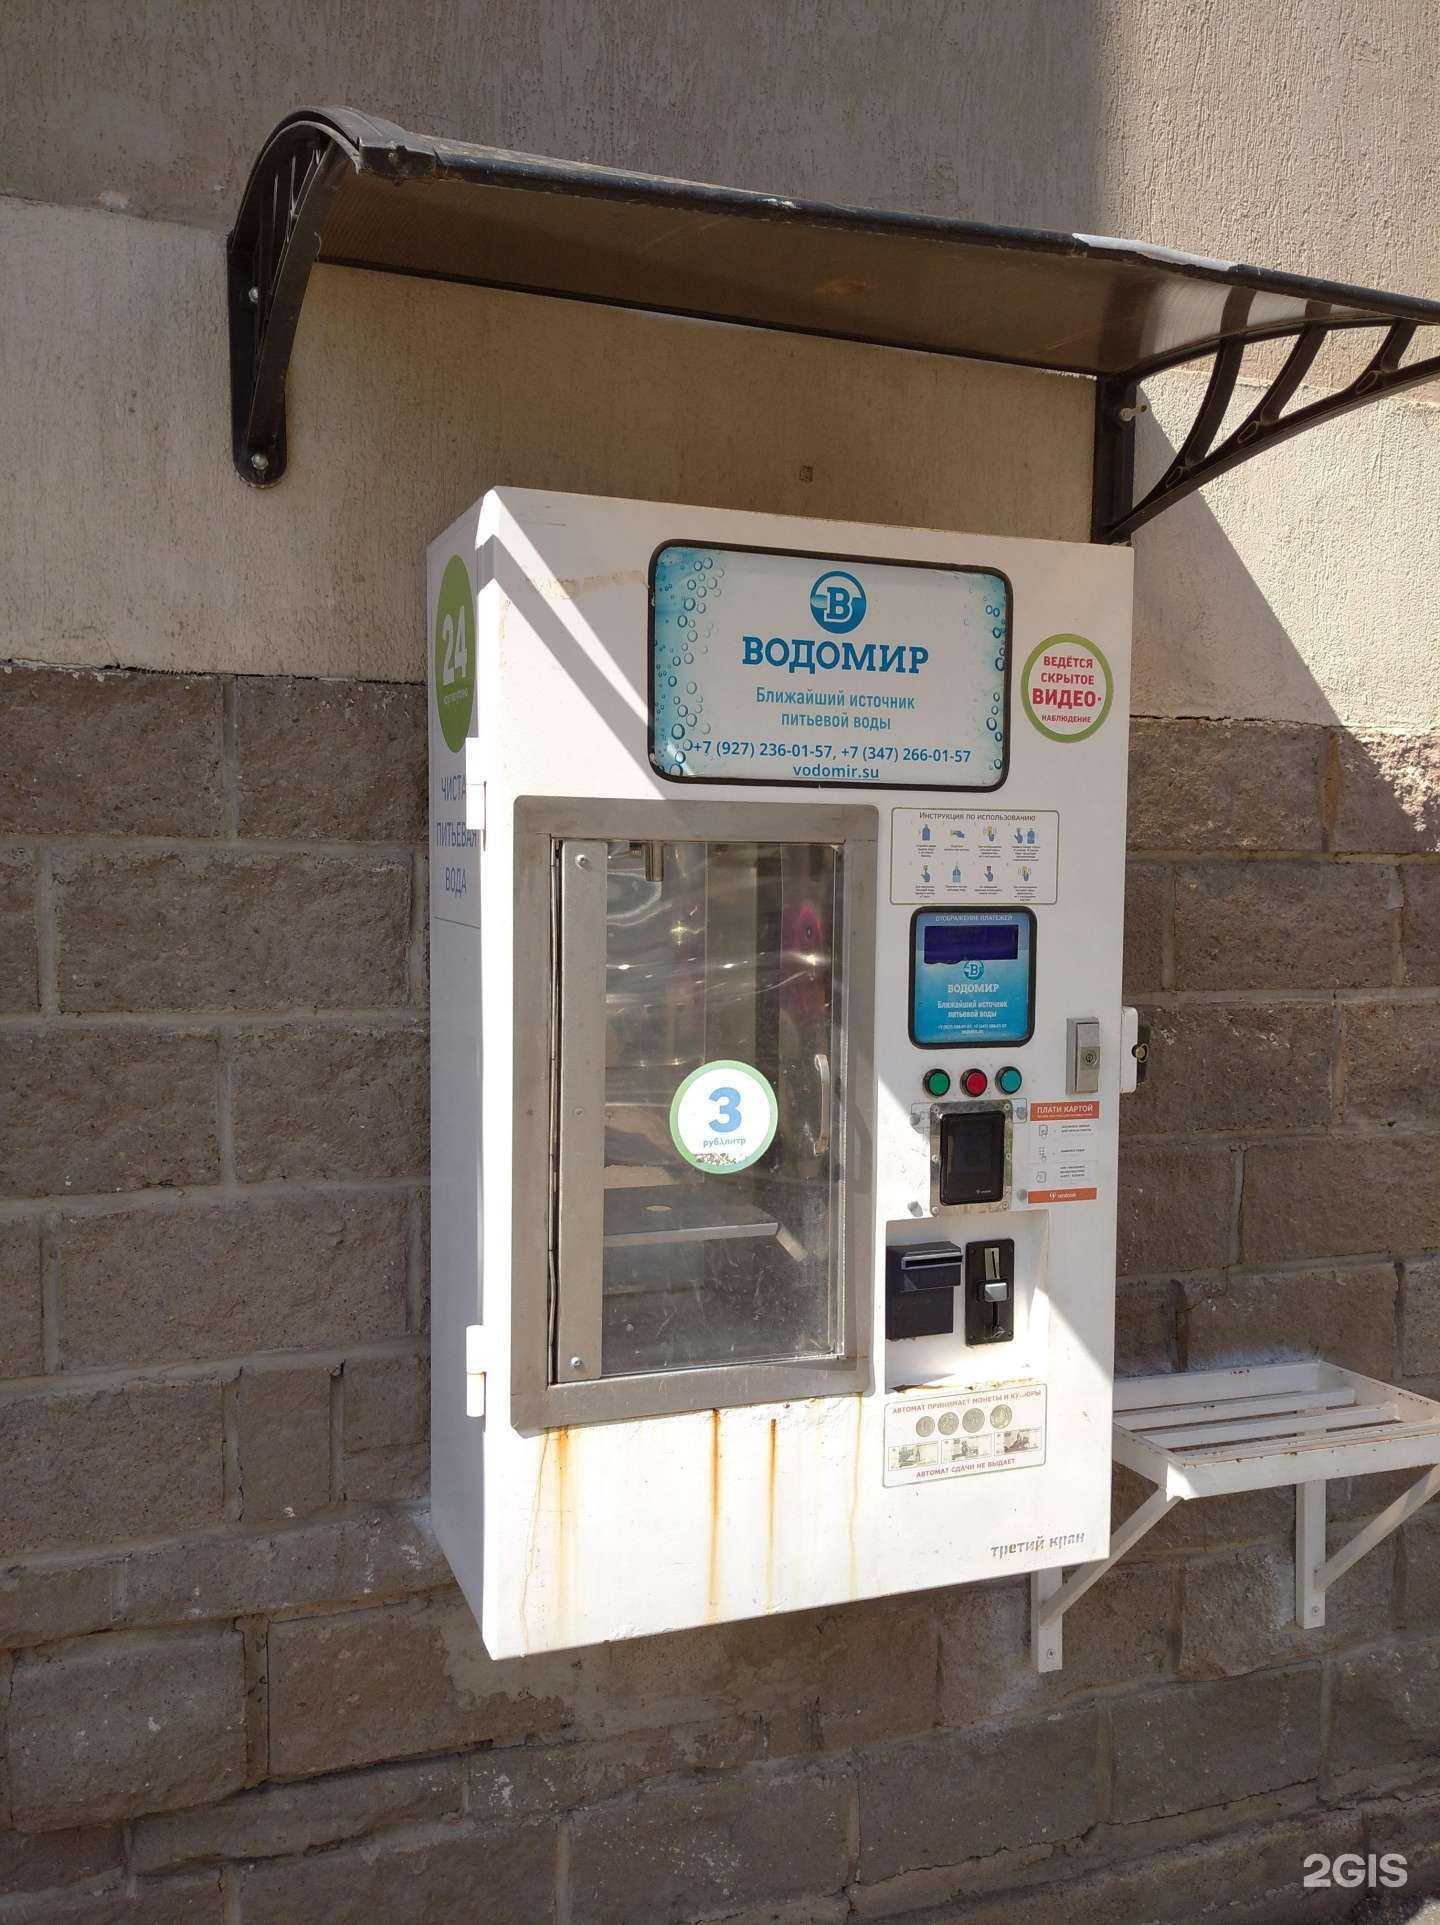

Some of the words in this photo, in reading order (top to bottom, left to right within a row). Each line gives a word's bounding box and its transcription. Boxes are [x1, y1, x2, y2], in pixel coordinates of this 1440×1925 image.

[442, 604, 468, 687] 24
[742, 635, 929, 675] ВОДОМИР
[1043, 655, 1094, 669] ВЕДЁТСЯ
[1040, 672, 1095, 685] СКРЫТОЕ
[756, 686, 845, 707] Ближайший
[850, 693, 916, 710] источник
[1032, 687, 1102, 709] ВИДЕО-
[781, 712, 849, 729] питьевой
[854, 715, 891, 731] воды
[1041, 714, 1092, 724] НАБЛЮДЕНИЕ
[693, 740, 712, 754] +7
[716, 741, 755, 758] (927)
[760, 743, 837, 761] 236-01-57,
[841, 746, 858, 759] +7
[863, 746, 899, 763] (347)
[903, 748, 971, 763] 266-01-57
[793, 763, 880, 779] vodomir.su
[441, 774, 467, 801] ЧИСТА
[445, 866, 467, 897] ВОДА
[948, 984, 1000, 994] ВОДОМИР
[708, 1087, 743, 1133] 3
[1037, 1105, 1062, 1114] ПЛАТИ
[1064, 1103, 1094, 1113] КАРТОЙ
[892, 1404, 926, 1415] АВТОМАТ
[972, 1394, 1002, 1405] МОНЕТЫ
[916, 1467, 949, 1479] АВТОМАТ
[951, 1464, 975, 1474] СДАЧИ
[976, 1462, 986, 1470] НЕ
[987, 1457, 1016, 1468] ВЫДАЕТ
